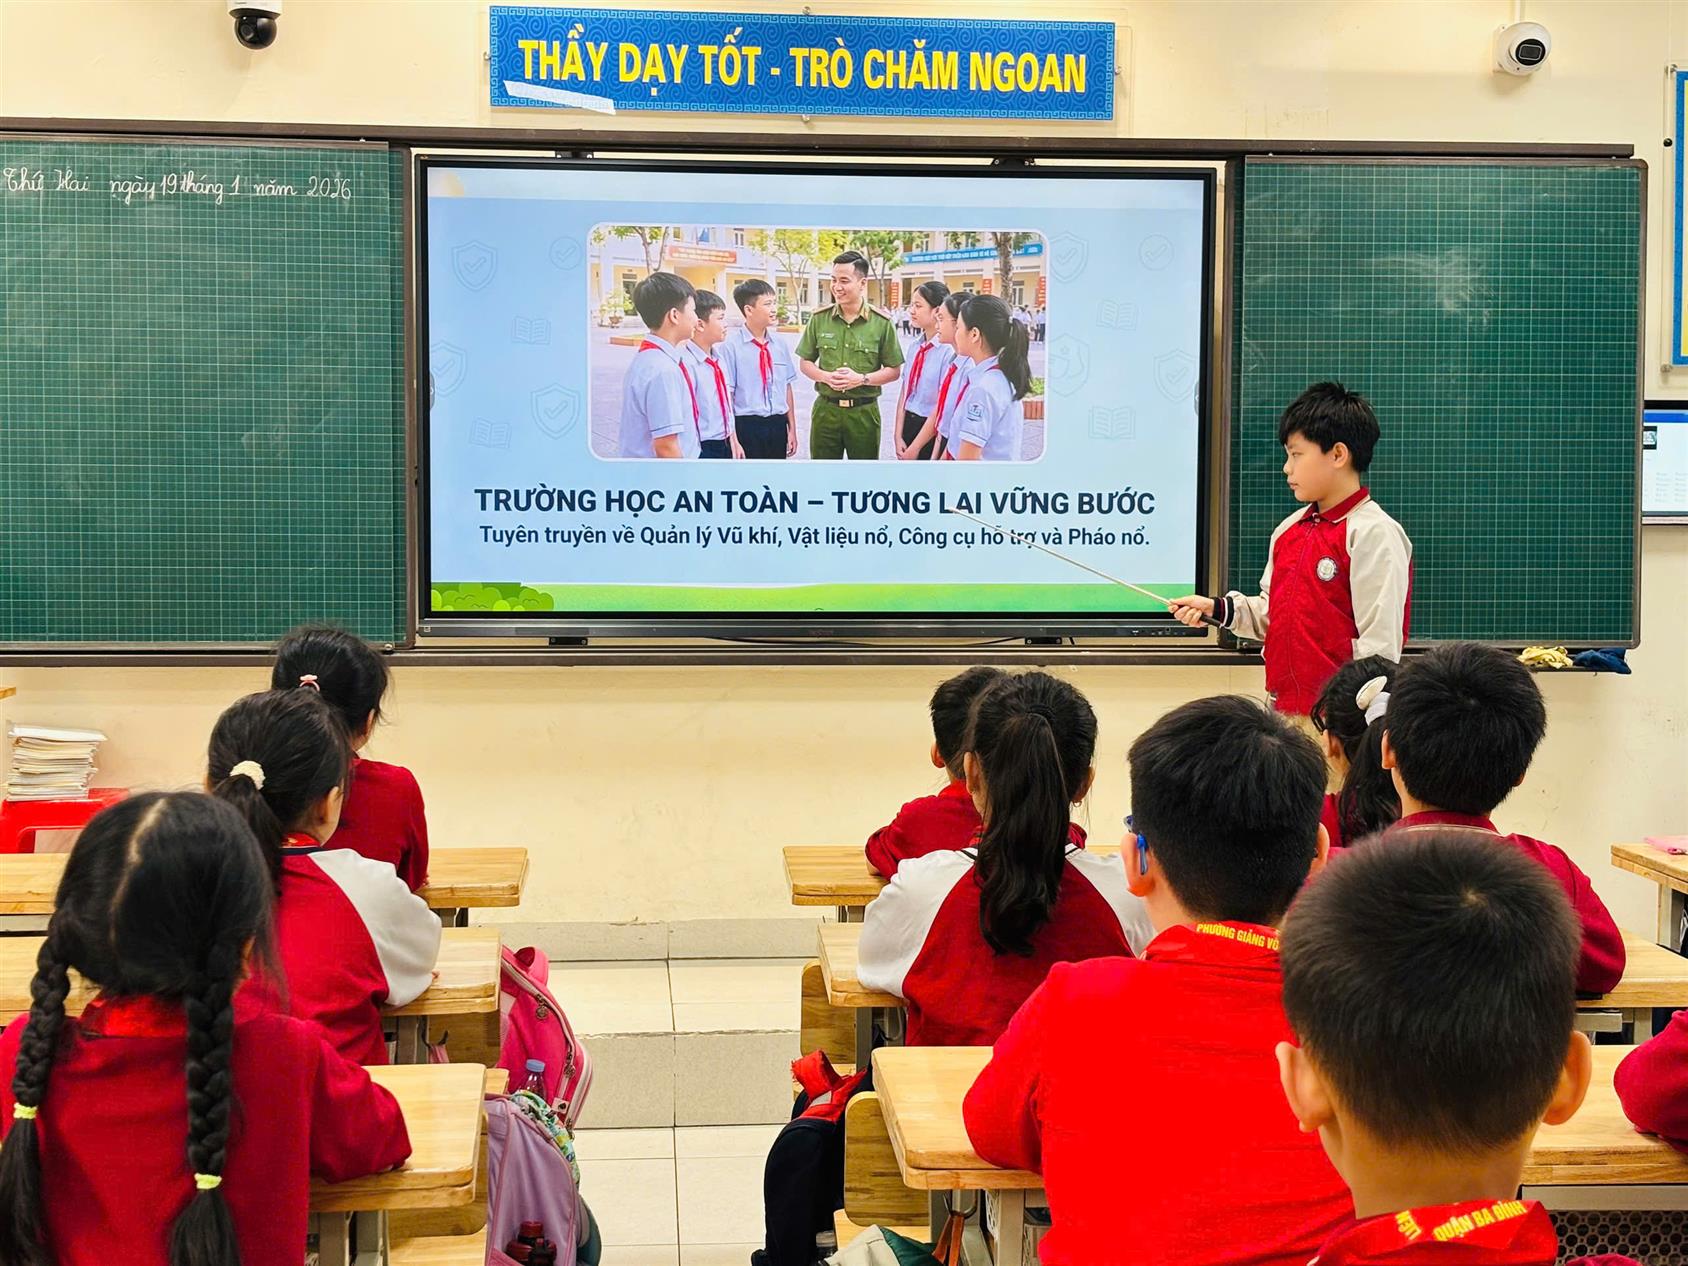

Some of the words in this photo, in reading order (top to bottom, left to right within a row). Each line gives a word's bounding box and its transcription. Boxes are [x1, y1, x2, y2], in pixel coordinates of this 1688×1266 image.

[518, 24, 608, 81] THẦY
[618, 43, 688, 96] DẠY
[698, 27, 761, 86] TỐT
[771, 67, 780, 75] -
[789, 37, 853, 89] TRÒ
[863, 39, 958, 90] CHĂM
[969, 52, 1086, 93] NGOAN
[3, 167, 44, 191] Thứ
[54, 169, 88, 191] Hai
[110, 175, 155, 205] ngày
[179, 170, 224, 205] tháng
[229, 175, 241, 195] 1
[254, 179, 297, 196] năm
[307, 176, 351, 199] 2026
[474, 483, 597, 512] TRƯỜNG
[605, 490, 665, 518] HỌC
[673, 491, 713, 513] AN
[721, 485, 798, 514] TOÀN
[831, 491, 930, 514] TƯƠNG
[939, 491, 981, 514] LAI
[990, 487, 1069, 514] VỮNG
[1078, 487, 1155, 514] BƯỚC
[479, 525, 539, 547] Tuyên
[545, 524, 606, 547] truyền
[612, 525, 635, 544] về
[640, 525, 690, 546] Quản
[696, 525, 711, 548] lý
[717, 526, 742, 545] Vũ
[749, 526, 782, 548] khí,
[788, 525, 820, 547] Vật
[825, 525, 859, 548] liệu
[865, 524, 893, 548] nổ,
[899, 526, 947, 549] Công
[953, 530, 975, 549] cụ
[1041, 526, 1063, 545] và
[1069, 526, 1116, 545] Pháo
[1121, 524, 1150, 546] nổ.
[1432, 1214, 1475, 1241] QUẬN
[1471, 1207, 1496, 1227] BA
